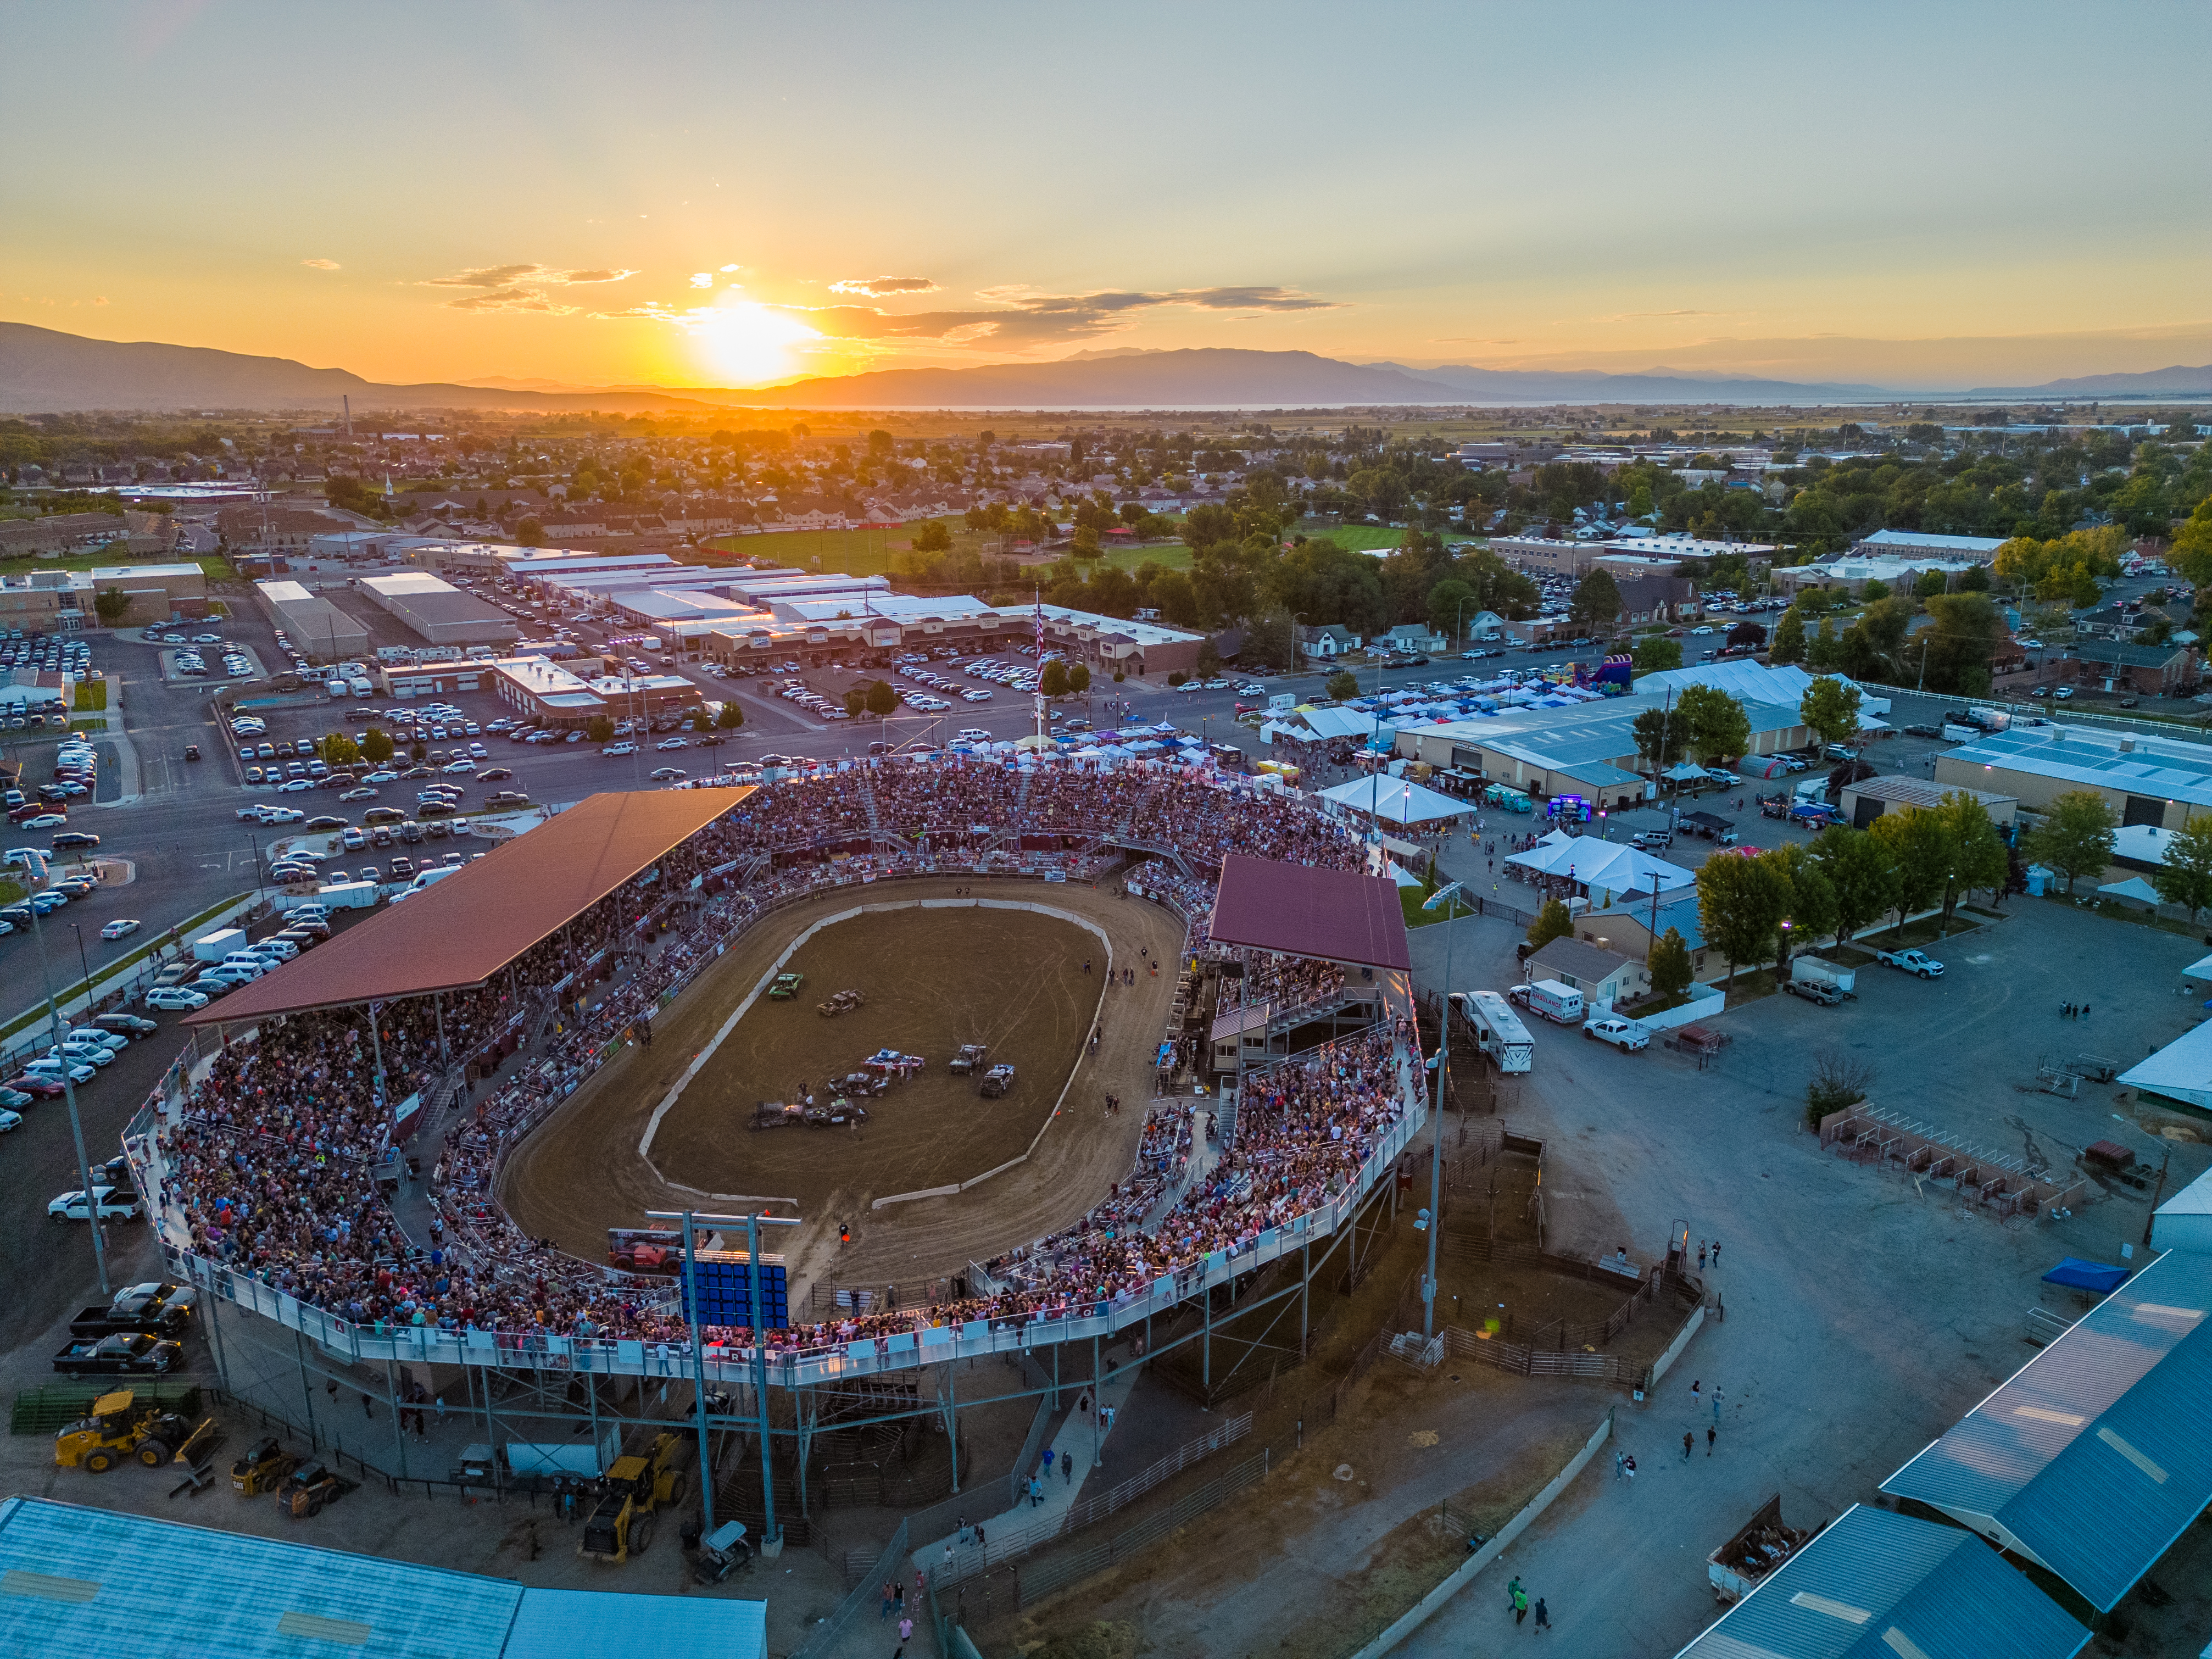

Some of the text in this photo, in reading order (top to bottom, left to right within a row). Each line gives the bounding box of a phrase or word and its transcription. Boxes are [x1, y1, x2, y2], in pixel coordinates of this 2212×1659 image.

[1531, 993, 1562, 1009] AMBULANCE
[337, 1324, 343, 1332] A
[732, 1352, 739, 1361] R
